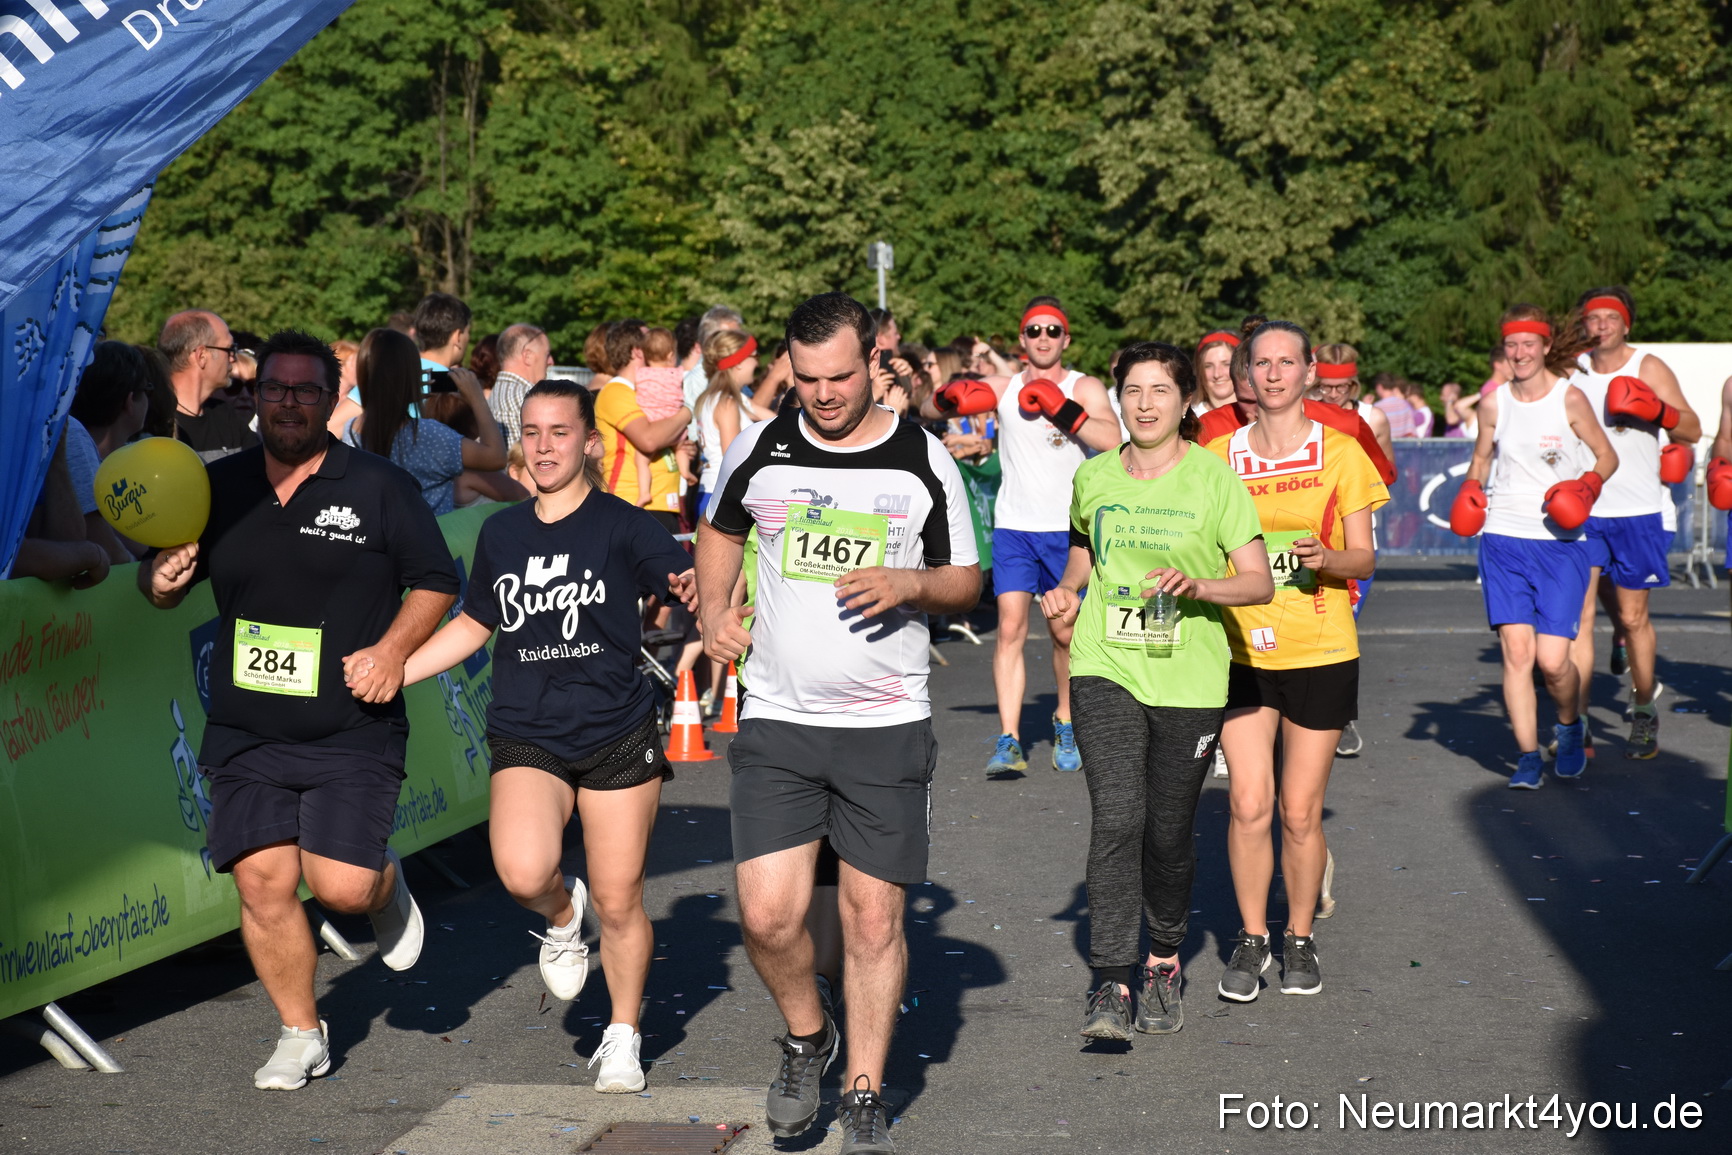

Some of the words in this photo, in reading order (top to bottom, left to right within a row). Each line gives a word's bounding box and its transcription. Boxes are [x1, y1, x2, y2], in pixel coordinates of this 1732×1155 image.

[1247, 483, 1269, 496] AX
[1276, 476, 1324, 493] BÖGL
[104, 481, 147, 521] Burgis
[873, 493, 912, 510] OM
[314, 508, 361, 530] Burgis
[1135, 505, 1196, 520] Zahnarztpraxis
[299, 526, 327, 537] Weil's
[328, 531, 352, 541] guad
[355, 535, 366, 544] is!
[887, 526, 905, 537] HT!
[1115, 524, 1126, 534] Dr.
[1129, 525, 1137, 534] R.
[1140, 525, 1183, 538] Silberhorn
[796, 532, 872, 566] 1467
[885, 540, 902, 549] nde
[1115, 539, 1126, 548] ZA
[1128, 540, 1137, 549] M.
[1140, 540, 1171, 552] Michalk
[794, 559, 851, 573] Großekatthöfer
[1268, 553, 1303, 574] 40
[493, 568, 606, 641] Burgis
[1116, 630, 1146, 638] Mintemur
[0, 619, 34, 687] nde
[38, 612, 93, 669] Firmen
[518, 643, 605, 662] Knidelliebe.
[248, 647, 297, 675] 284
[243, 670, 275, 681] Schönfeld
[276, 675, 302, 684] Markus
[46, 652, 104, 740] länger!
[1199, 733, 1216, 743] JUST
[390, 777, 448, 840] berpfalz.de
[0, 882, 170, 984] irmenlauf-oberpfalz.de
